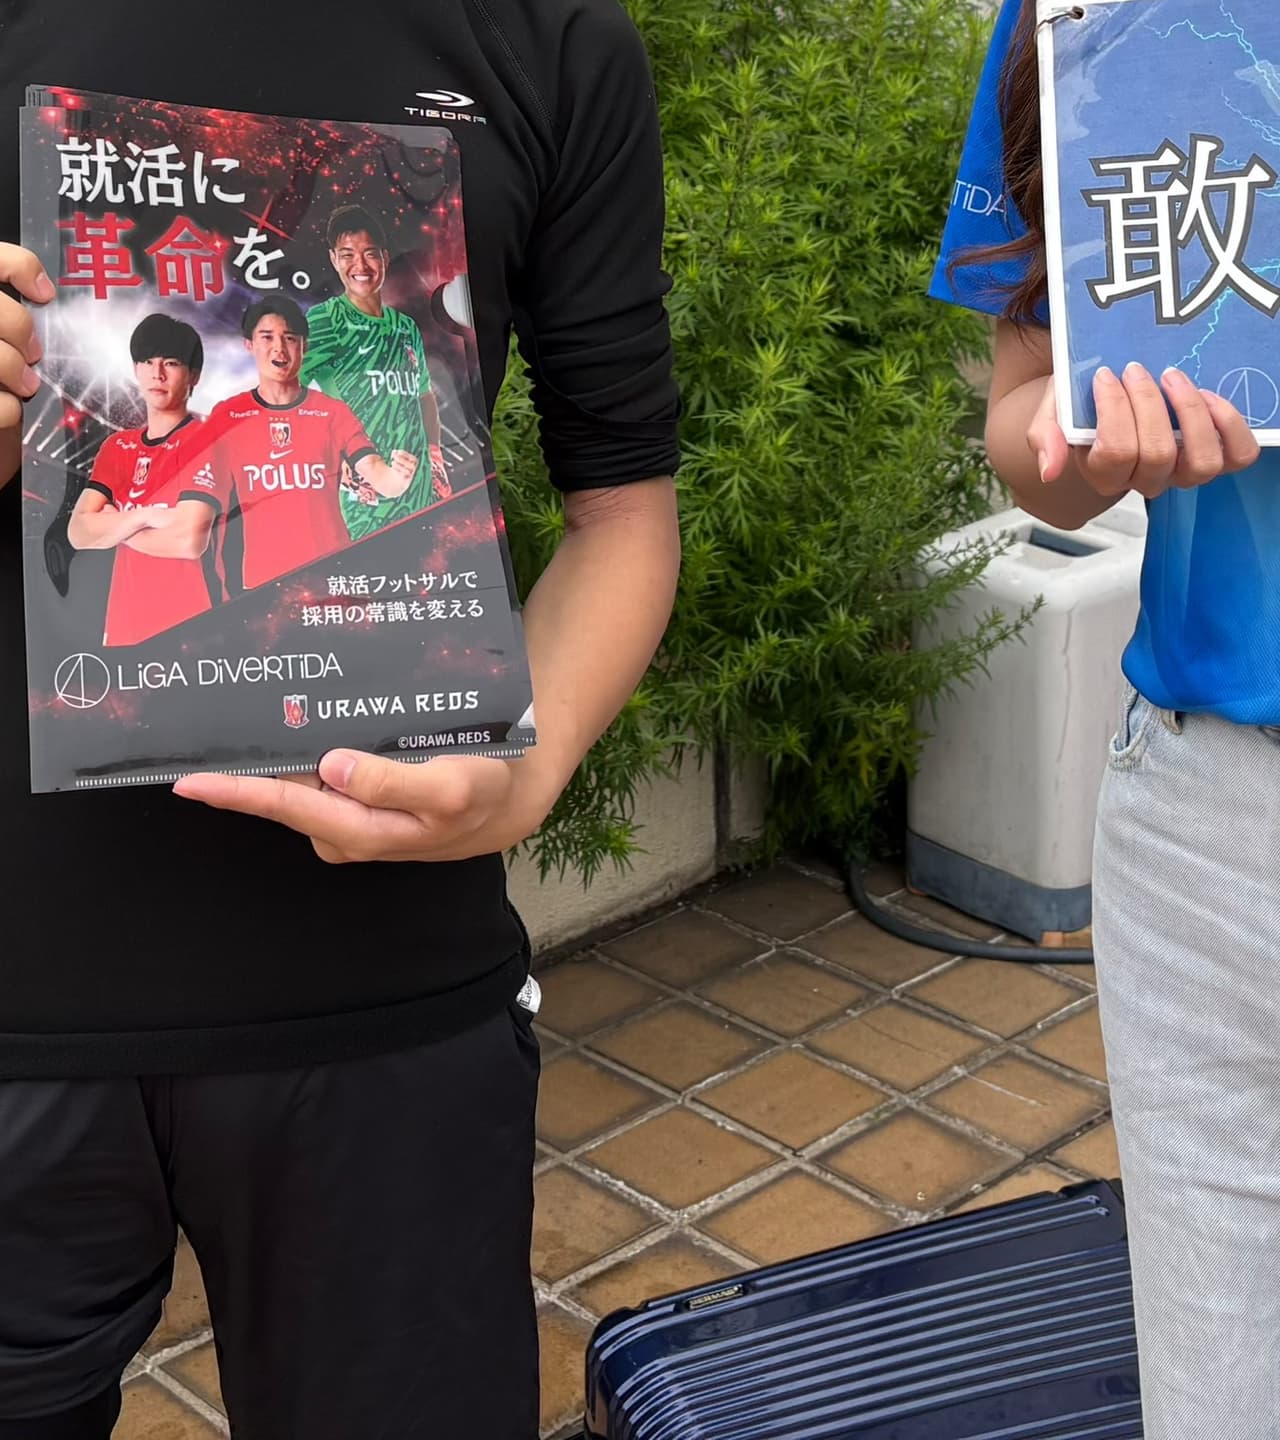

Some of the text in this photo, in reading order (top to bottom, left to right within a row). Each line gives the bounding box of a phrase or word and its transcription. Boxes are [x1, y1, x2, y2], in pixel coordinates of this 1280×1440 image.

[55, 137, 246, 207] 就活に
[243, 463, 326, 491] POLUS
[326, 571, 479, 596] 就活フットサルで
[301, 599, 484, 627] 採用の常識を変える
[317, 690, 480, 720] URAWA REDS
[458, 730, 491, 745] REDS
